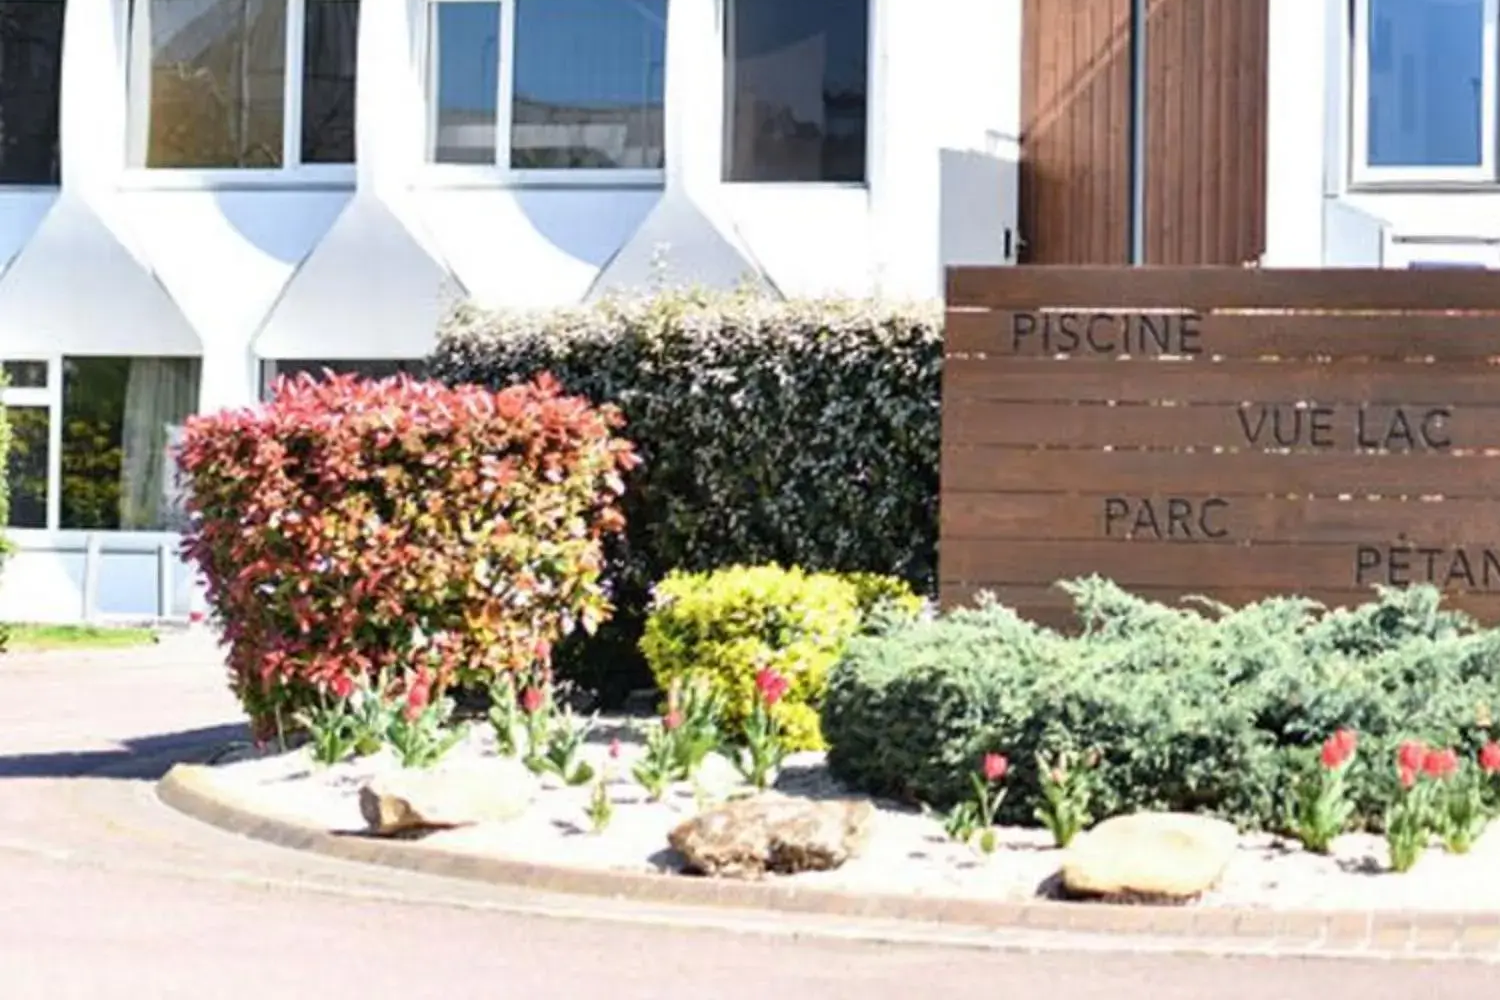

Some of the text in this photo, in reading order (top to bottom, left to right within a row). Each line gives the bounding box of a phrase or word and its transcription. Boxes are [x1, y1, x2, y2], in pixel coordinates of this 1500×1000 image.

[1012, 313, 1204, 354] PISCINE
[1236, 407, 1453, 449] VUE LAC
[1104, 497, 1230, 538] PARC
